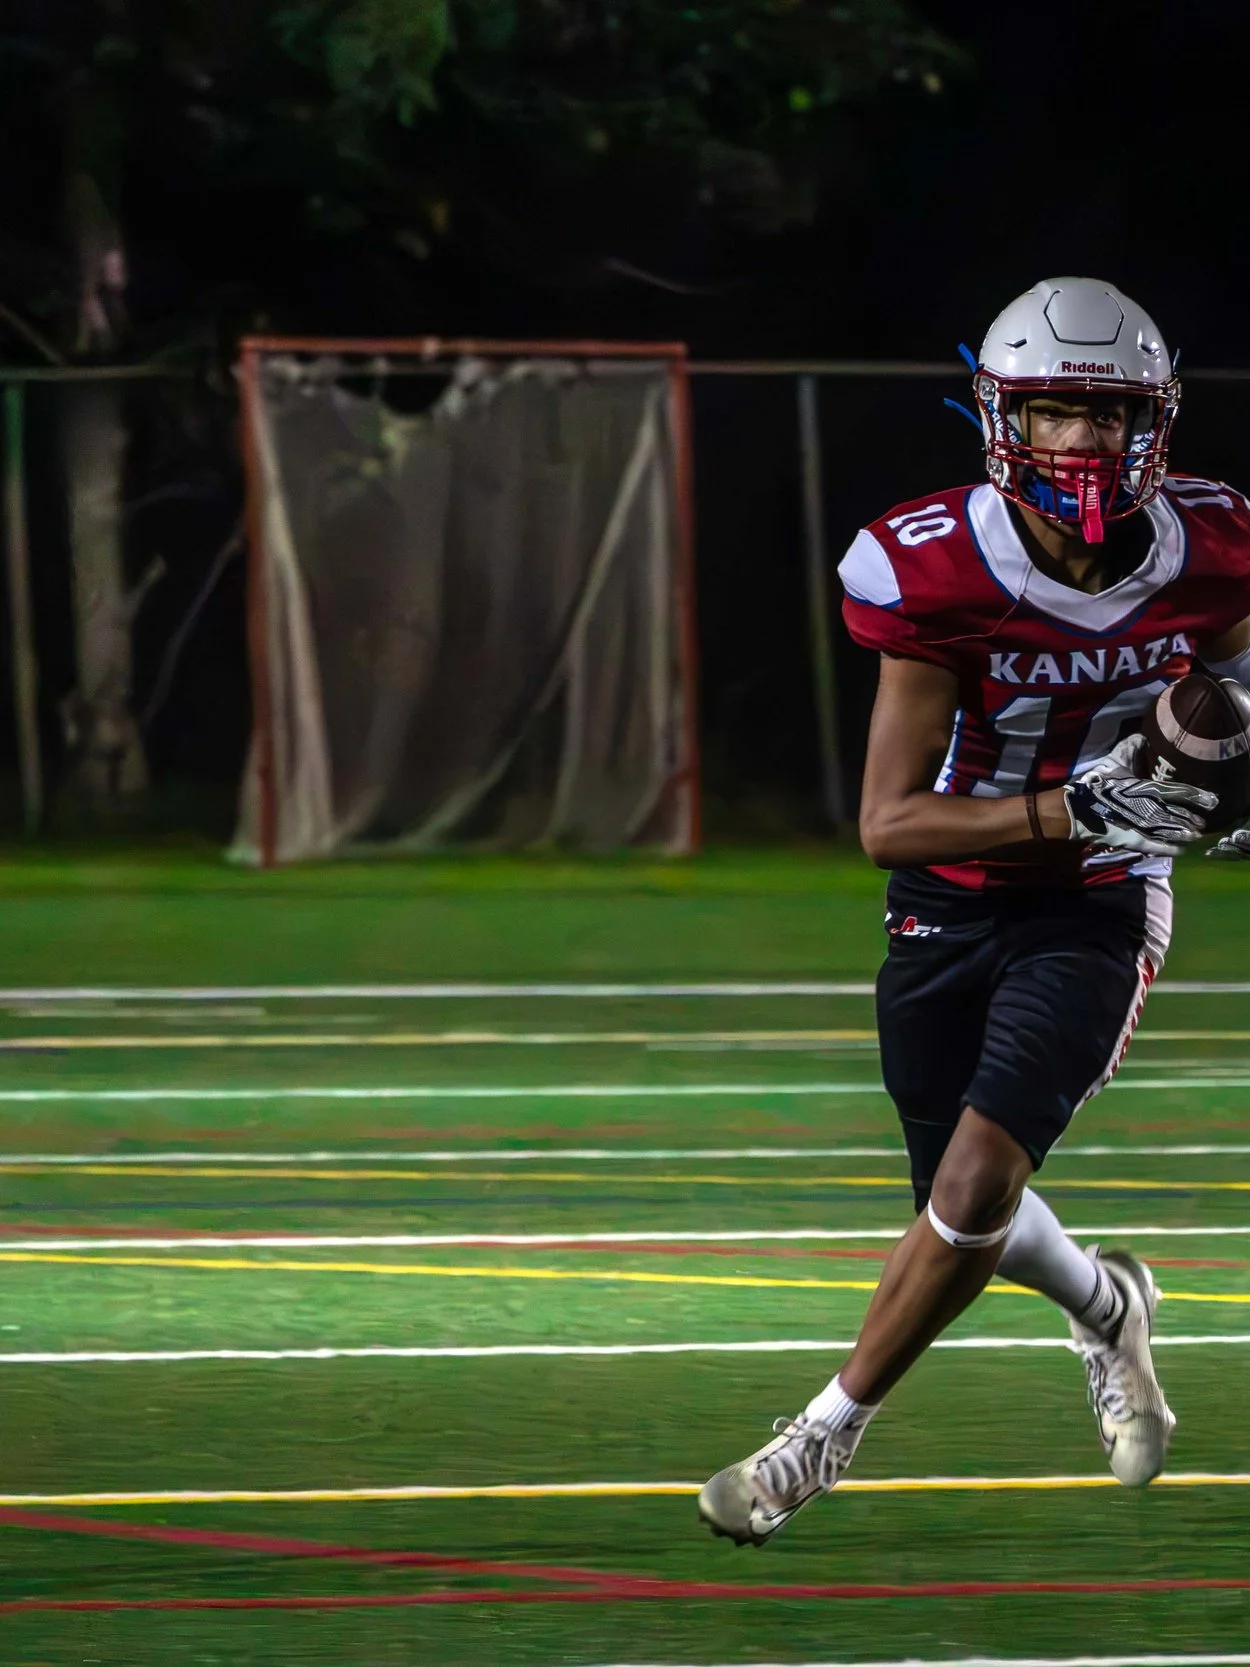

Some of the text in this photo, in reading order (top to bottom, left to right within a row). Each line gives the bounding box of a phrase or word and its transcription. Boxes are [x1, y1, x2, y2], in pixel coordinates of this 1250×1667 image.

[1061, 361, 1115, 375] Riddell
[885, 503, 957, 546] 10
[989, 632, 1193, 685] KANATA
